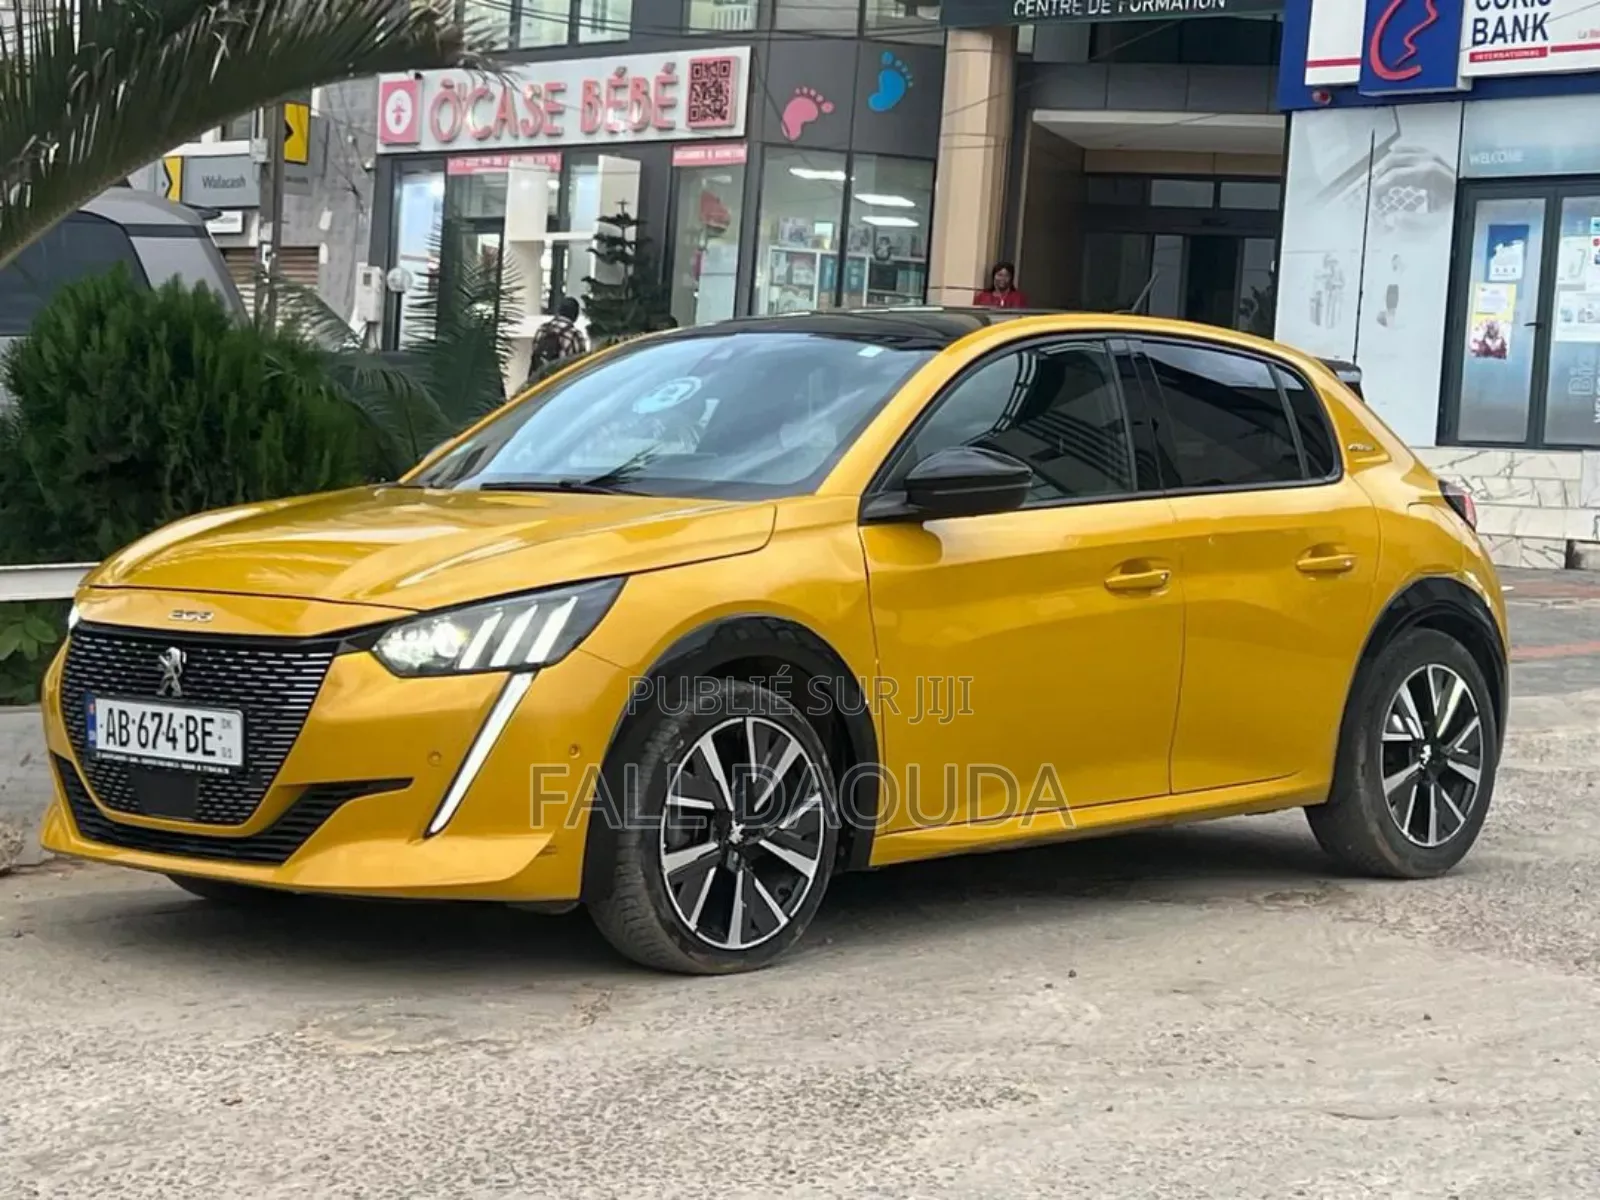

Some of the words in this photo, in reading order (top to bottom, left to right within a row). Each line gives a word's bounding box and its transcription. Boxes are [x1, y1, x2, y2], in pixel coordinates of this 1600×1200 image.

[1087, 0, 1111, 14] DE
[1472, 12, 1550, 46] BANK
[580, 61, 678, 134] BÉBÉ
